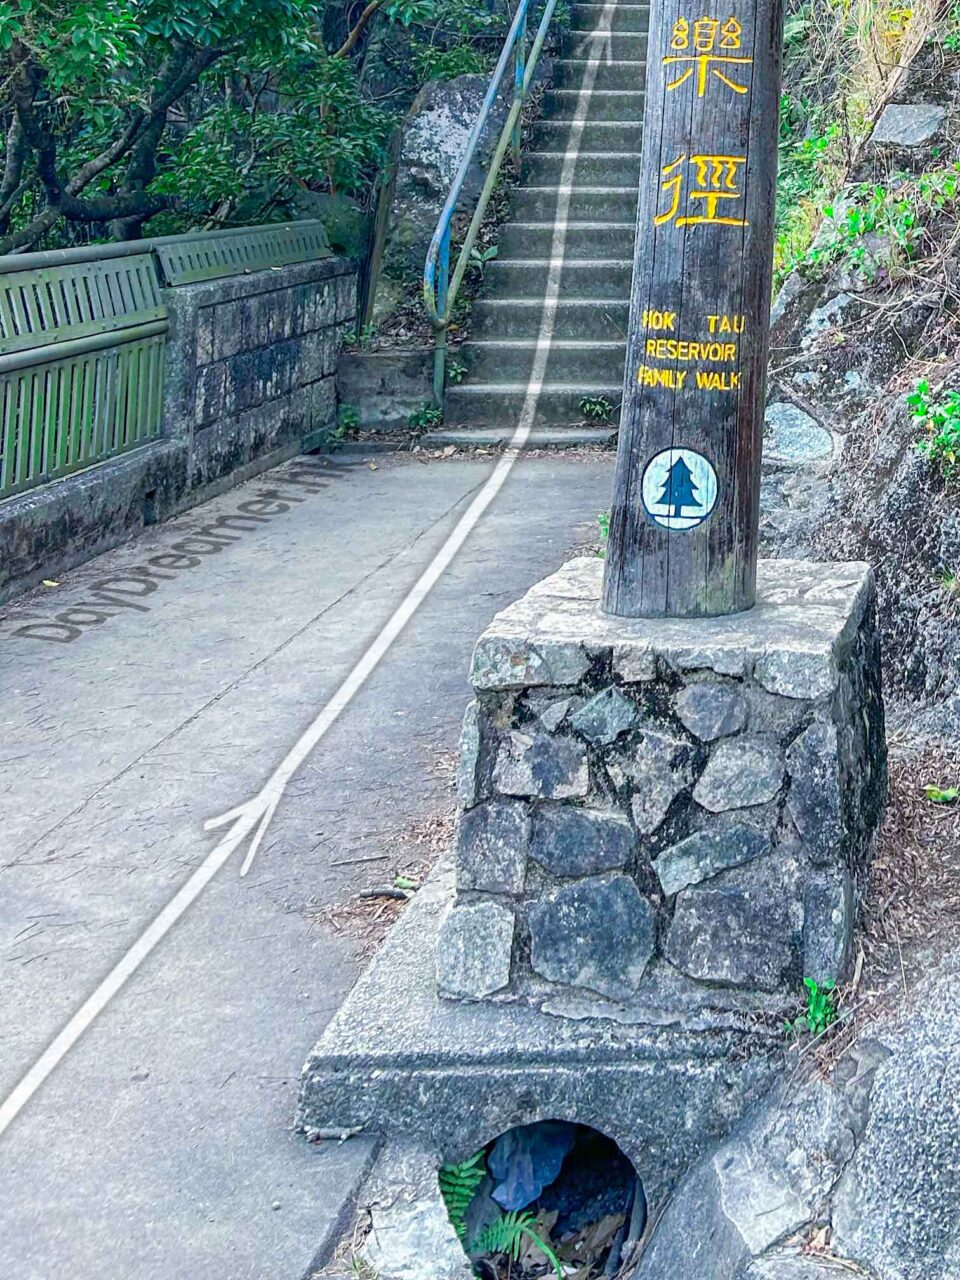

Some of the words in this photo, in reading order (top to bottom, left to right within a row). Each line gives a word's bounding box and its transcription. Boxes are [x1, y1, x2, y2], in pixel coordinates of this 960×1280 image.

[642, 309, 677, 332] HOK
[706, 315, 745, 334] TAU
[646, 338, 736, 362] RESERVOIR
[637, 364, 687, 390] FAMILY
[696, 370, 742, 391] WALK
